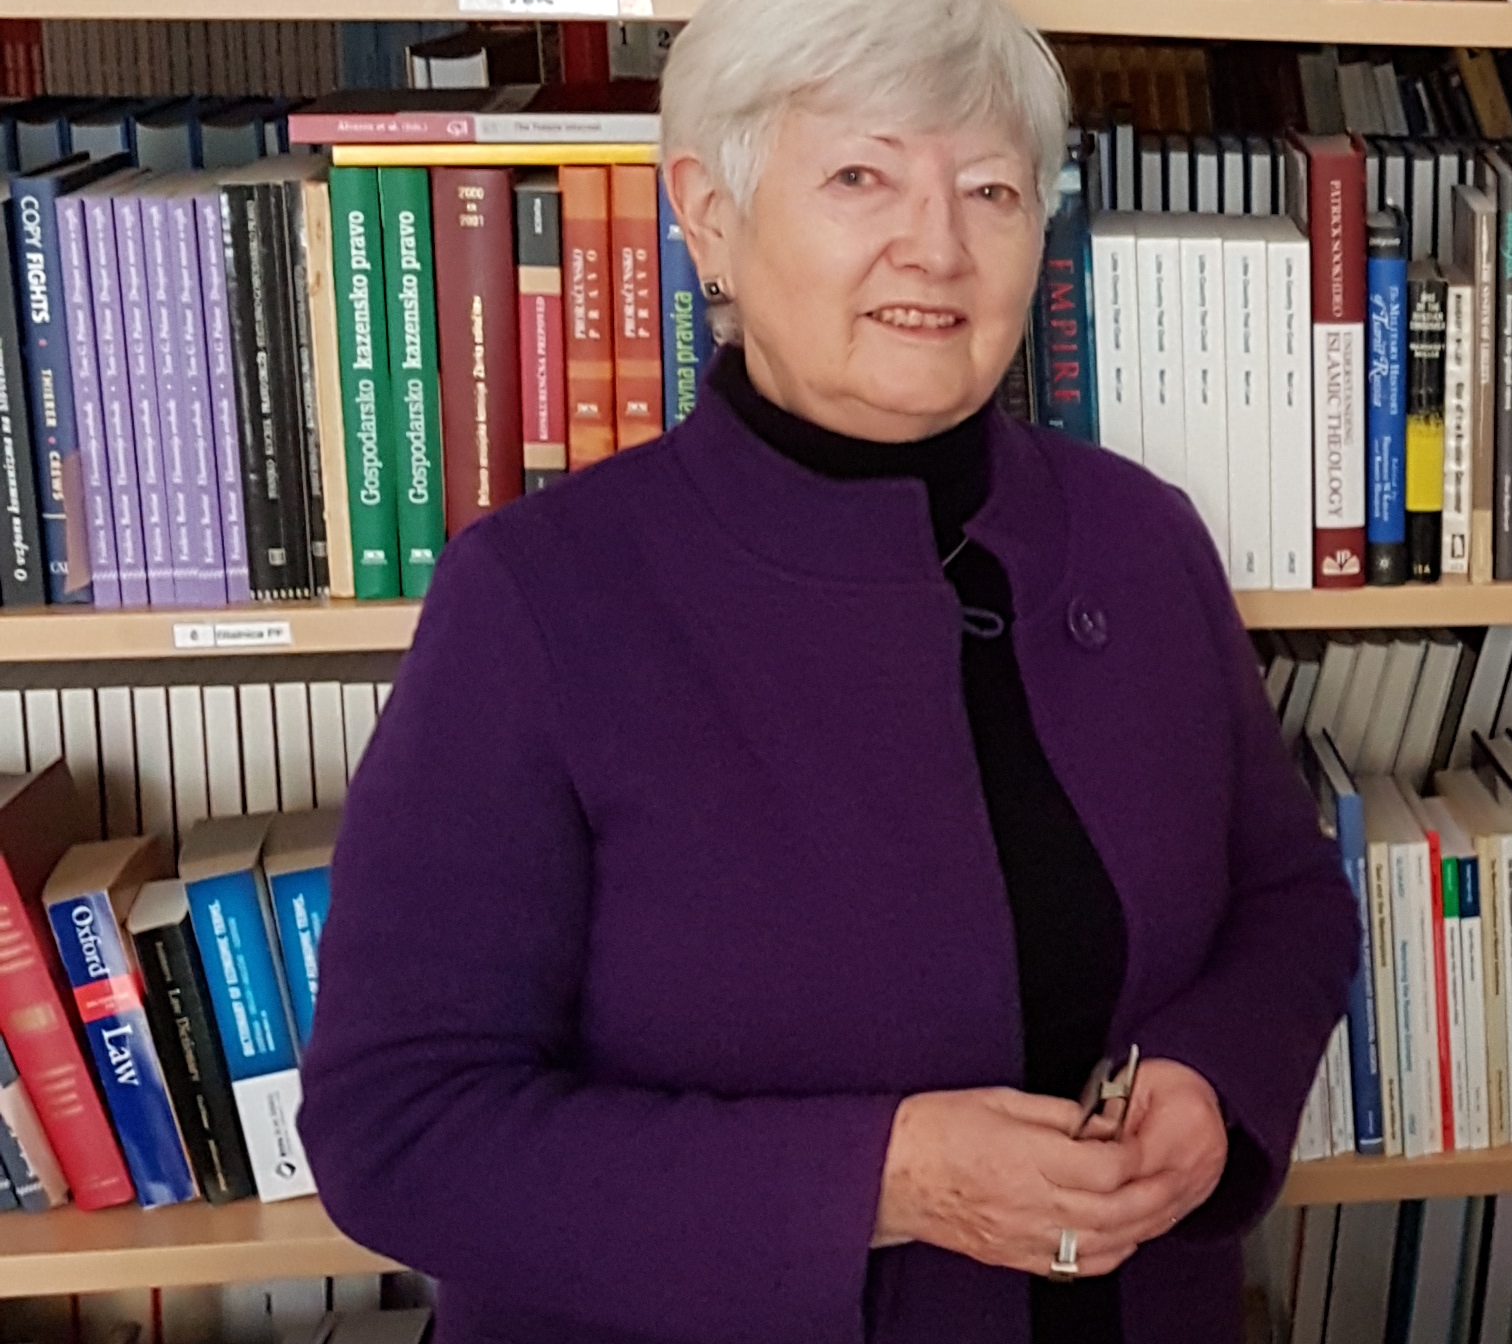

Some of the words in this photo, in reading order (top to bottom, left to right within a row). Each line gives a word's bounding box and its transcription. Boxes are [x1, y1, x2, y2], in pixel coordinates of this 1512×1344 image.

[20, 197, 41, 247] COPY
[348, 212, 369, 270] pravo
[397, 212, 420, 270] pravo
[1329, 180, 1343, 237] PATRICK
[25, 253, 49, 323] FIGHTS
[1330, 240, 1344, 317] SOOKHDEO
[350, 275, 373, 369] kazensko
[400, 275, 422, 368] kazensko
[673, 291, 699, 363] pravica
[1049, 259, 1081, 404] EMPIRE
[1325, 331, 1343, 407] ISLAMIC
[49, 451, 63, 501] CREWS
[357, 380, 382, 505] Gospodarsko
[406, 380, 430, 504] Gospodarsko
[1326, 412, 1344, 518] THEOLOGY
[70, 906, 109, 978] Oxford
[100, 1023, 140, 1086] Law
